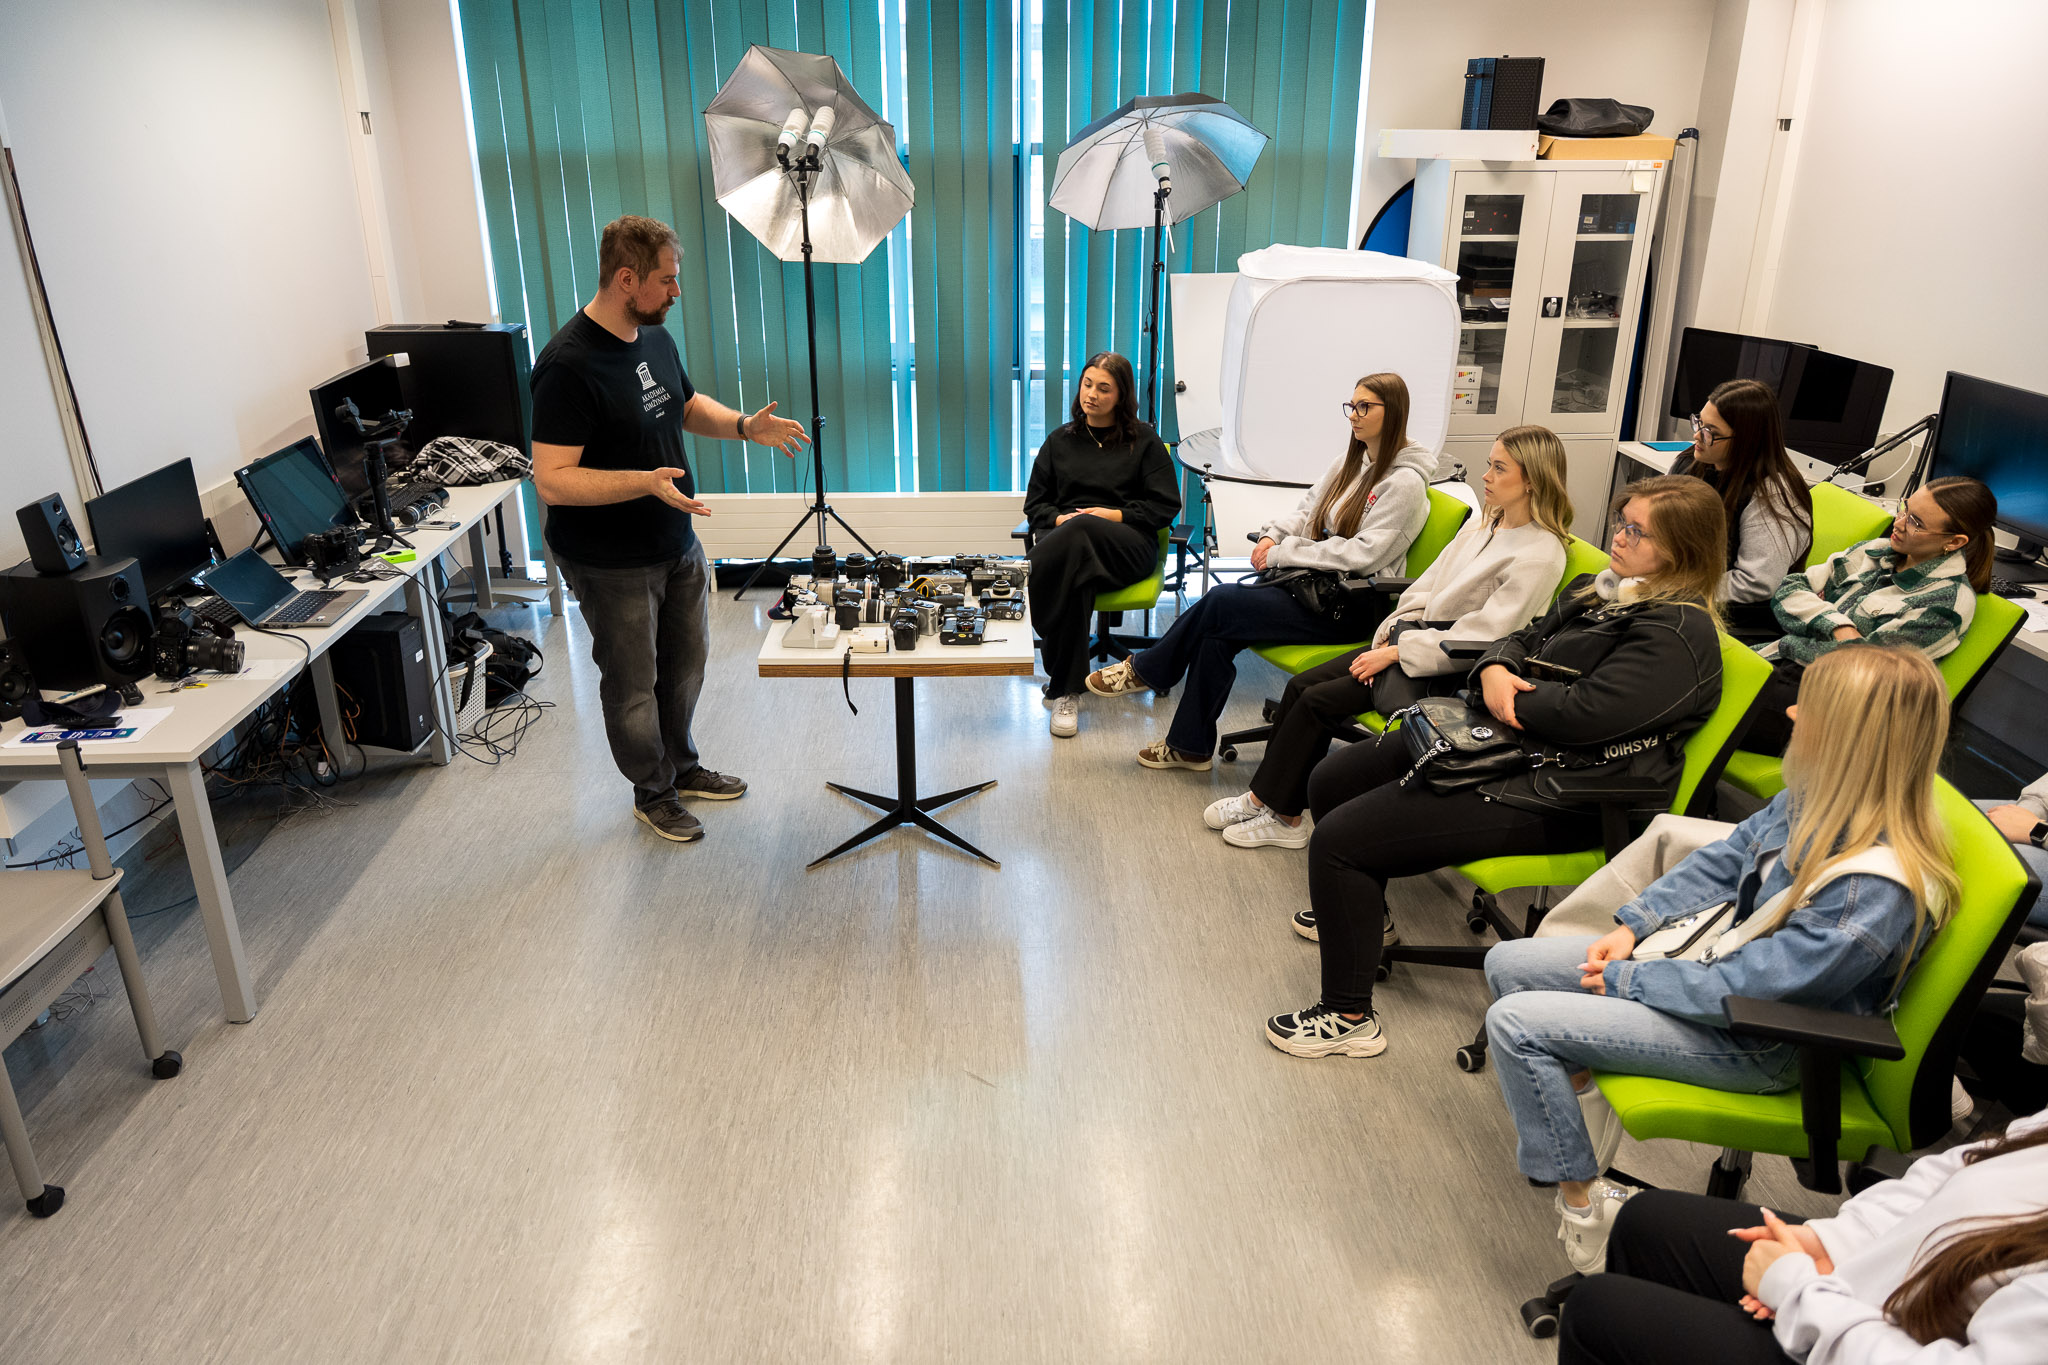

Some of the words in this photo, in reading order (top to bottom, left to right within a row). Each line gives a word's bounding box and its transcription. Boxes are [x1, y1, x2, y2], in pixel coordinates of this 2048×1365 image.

[641, 386, 666, 403] AKADEMIA
[1414, 748, 1439, 770] SHION
[1399, 769, 1415, 787] BAG
